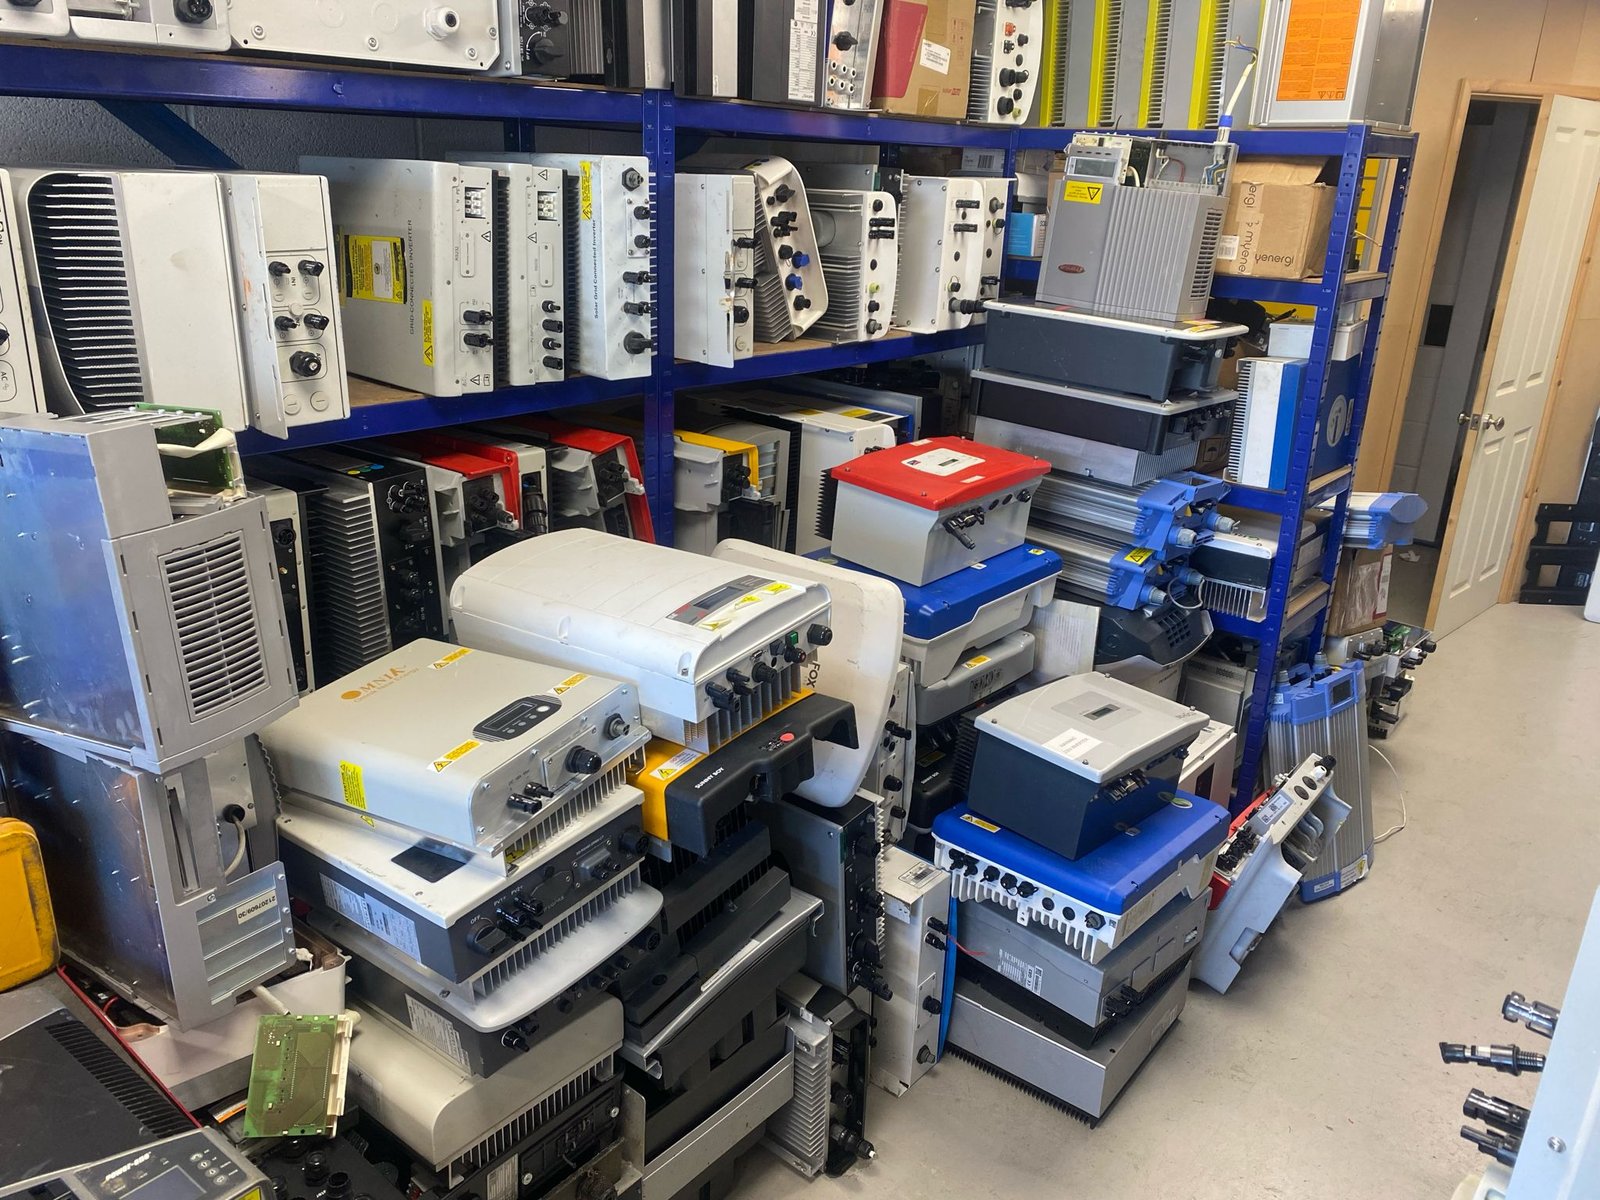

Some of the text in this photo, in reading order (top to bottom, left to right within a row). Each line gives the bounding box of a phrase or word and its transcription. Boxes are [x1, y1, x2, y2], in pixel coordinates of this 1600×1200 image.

[806, 661, 820, 688] FOX
[694, 766, 724, 790] SUNNY BOY
